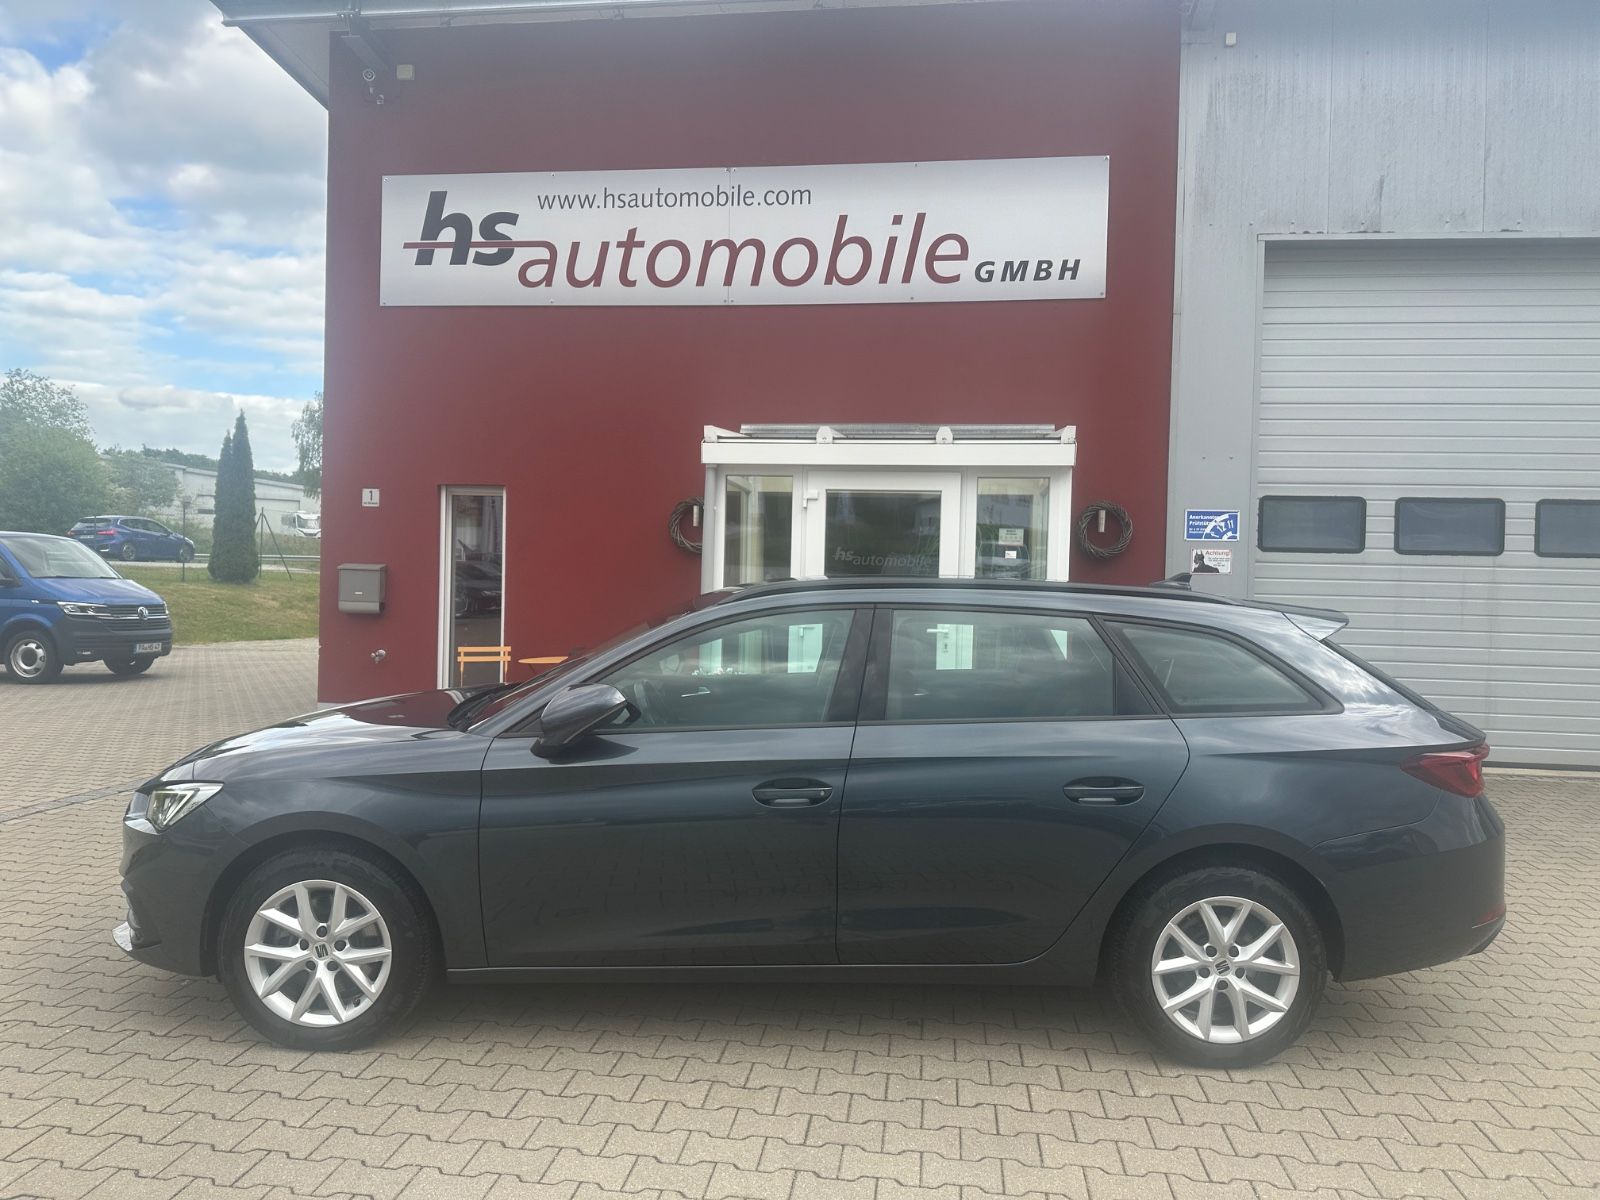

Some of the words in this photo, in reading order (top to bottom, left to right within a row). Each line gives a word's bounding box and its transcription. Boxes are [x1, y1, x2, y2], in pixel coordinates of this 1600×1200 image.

[537, 184, 812, 210] www.hsautomobile.com
[414, 190, 520, 266] hs
[517, 212, 970, 289] automobile
[974, 258, 1081, 283] GMBH
[368, 490, 373, 501] 1
